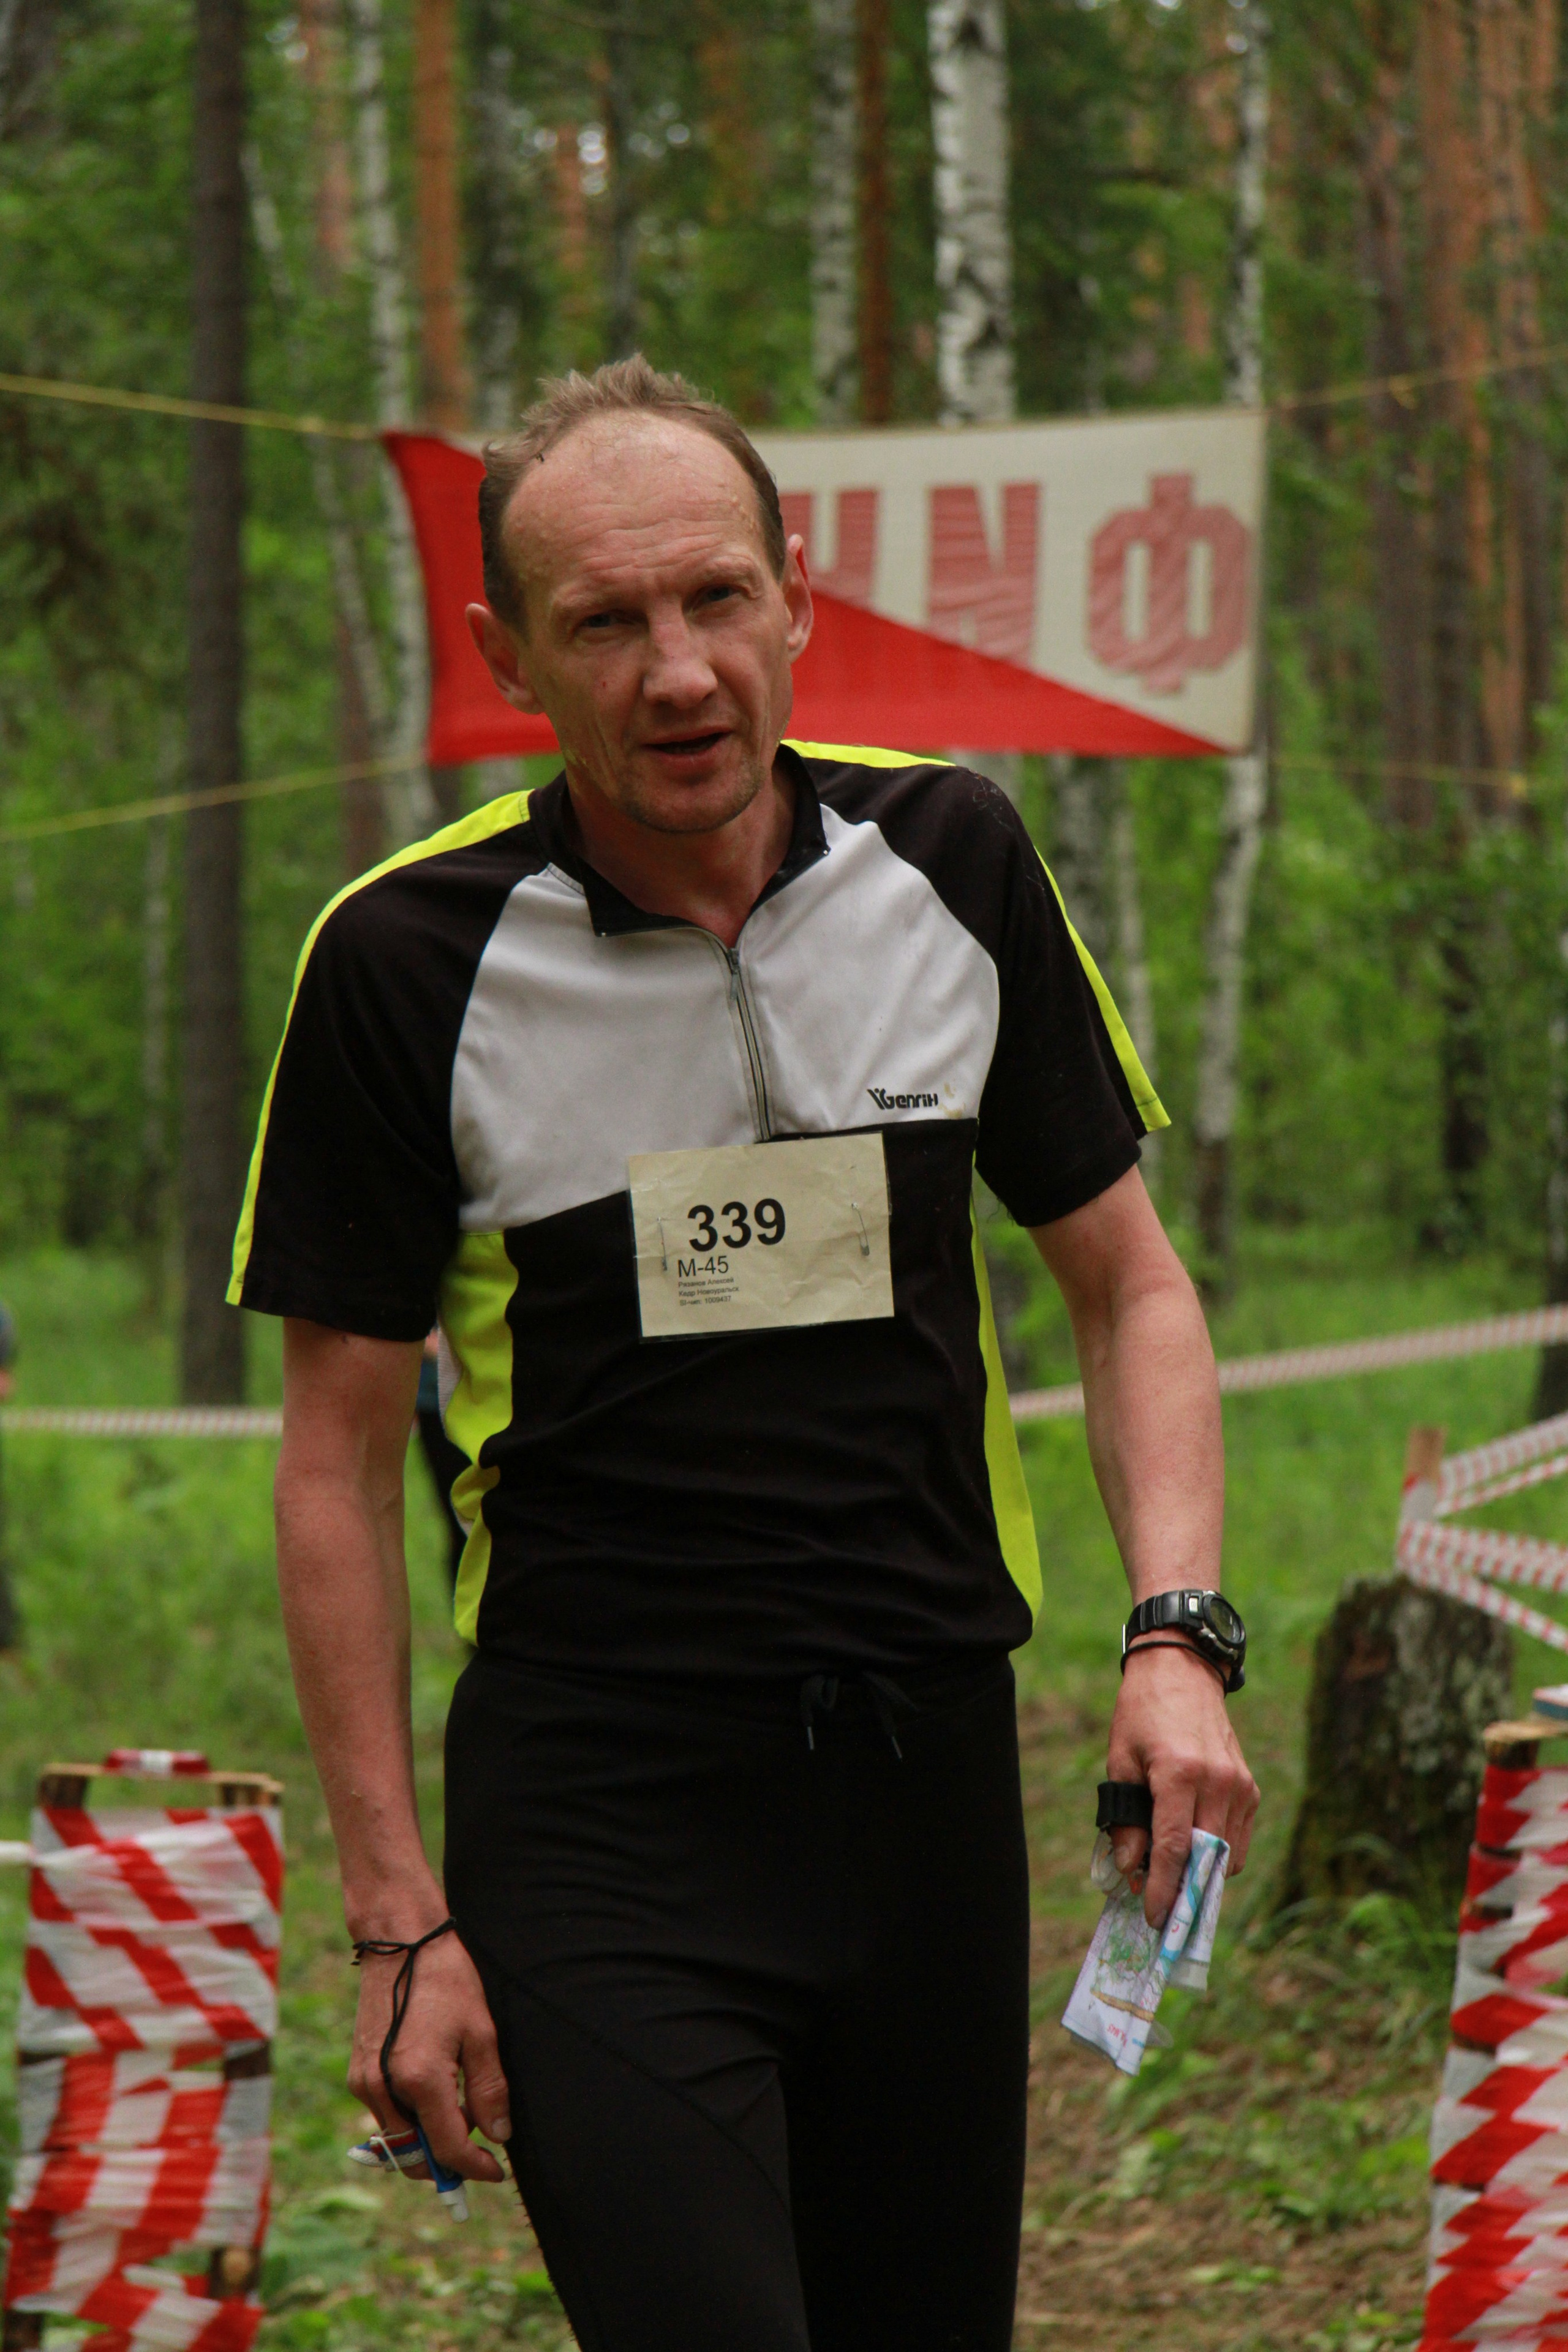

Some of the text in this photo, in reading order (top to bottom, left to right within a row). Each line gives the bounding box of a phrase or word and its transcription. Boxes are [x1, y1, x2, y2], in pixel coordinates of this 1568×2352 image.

[687, 1198, 786, 1252] 339
[707, 1276, 734, 1285] Алексей
[697, 1286, 739, 1295] Новоуральск
